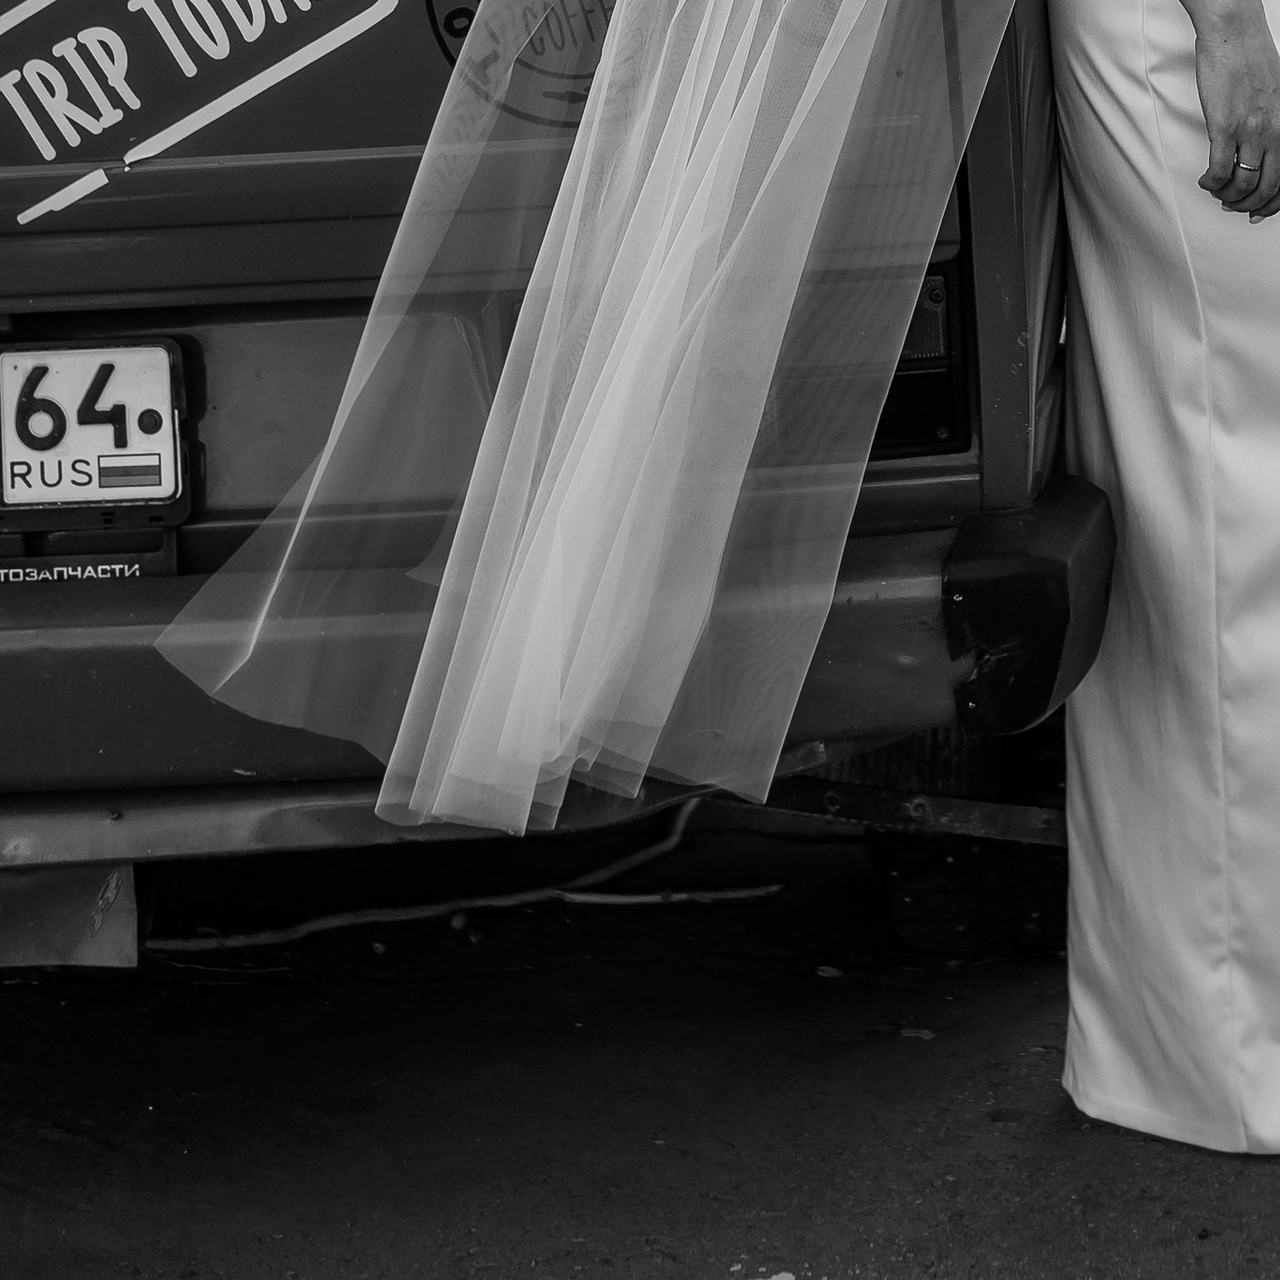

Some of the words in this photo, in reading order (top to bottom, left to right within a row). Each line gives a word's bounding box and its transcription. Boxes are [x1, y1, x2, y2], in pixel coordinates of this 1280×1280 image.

[0, 26, 141, 161] TRIP
[14, 362, 129, 452] 64
[9, 458, 94, 490] RUS
